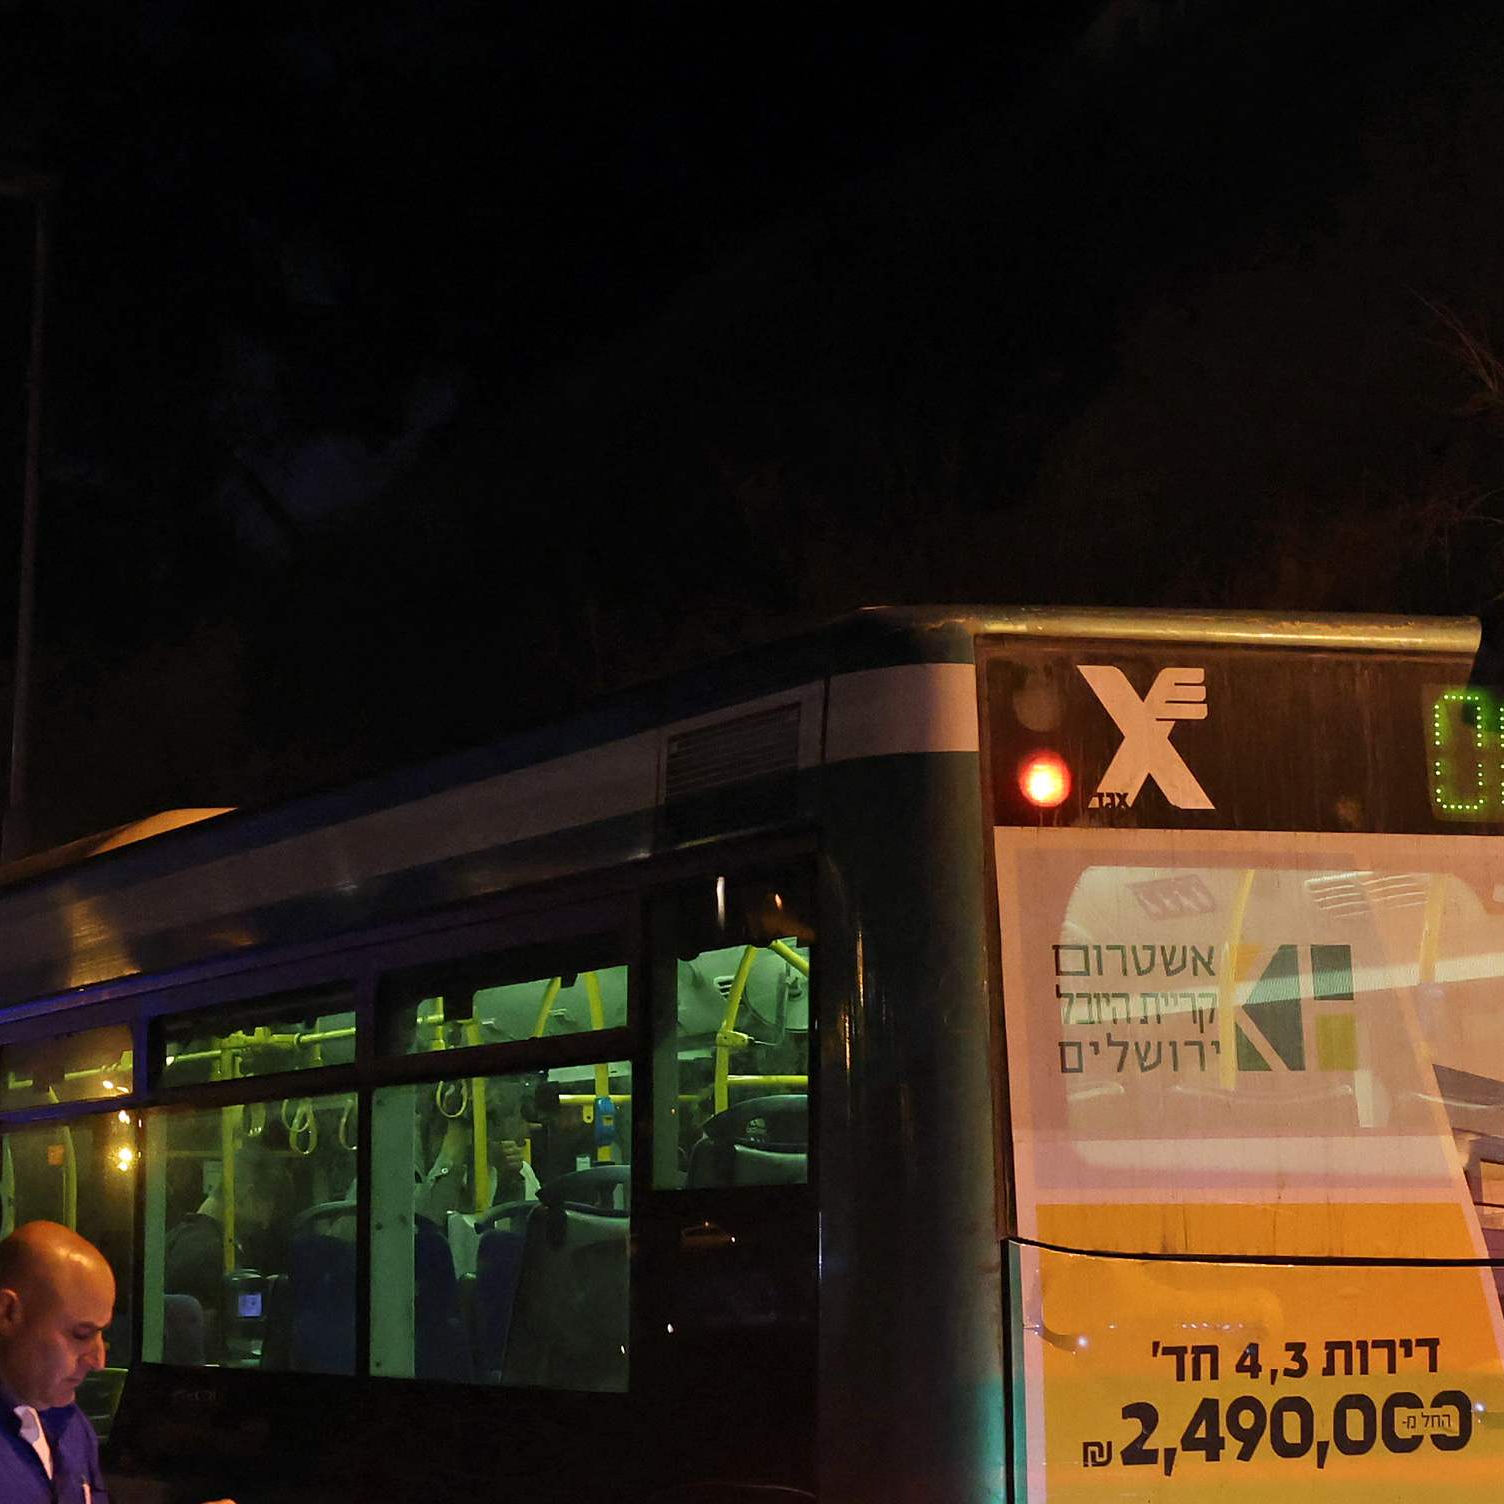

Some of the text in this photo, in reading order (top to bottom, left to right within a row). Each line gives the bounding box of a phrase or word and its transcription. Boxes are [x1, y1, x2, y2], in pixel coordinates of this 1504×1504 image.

[1051, 944, 1216, 977] אשטרום
[1055, 983, 1218, 1034] קריית היובל
[1058, 1032, 1221, 1073] ירושלים
[1151, 1337, 1440, 1385] דירות 4,3 חד'
[1421, 1411, 1451, 1428] החל
